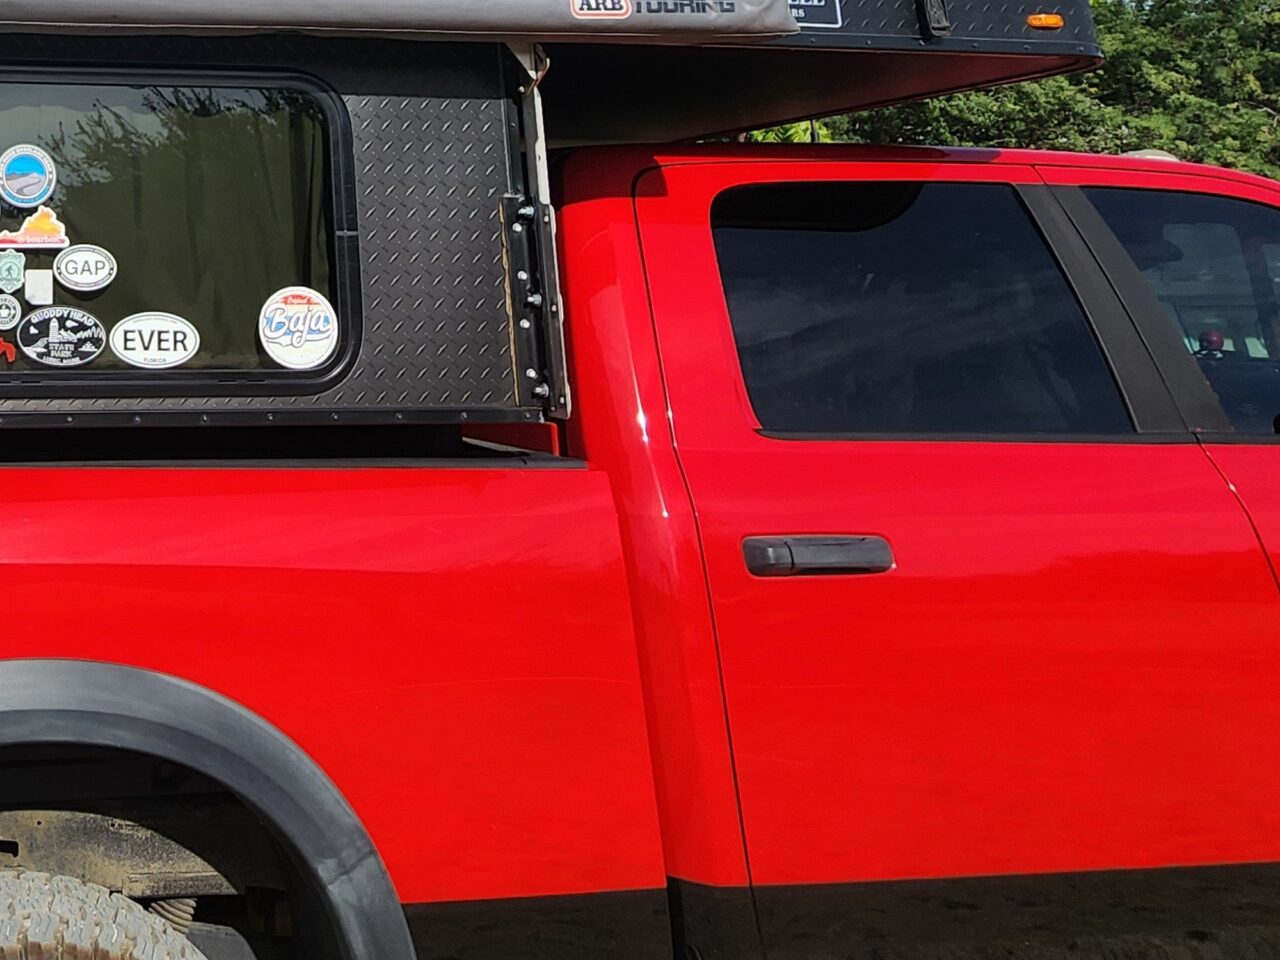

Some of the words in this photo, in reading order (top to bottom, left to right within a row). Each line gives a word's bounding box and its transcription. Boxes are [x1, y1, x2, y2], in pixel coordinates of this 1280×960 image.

[65, 259, 106, 276] GAP
[31, 309, 70, 324] QUODDY
[70, 310, 95, 327] HEAD
[263, 303, 332, 348] Baja
[123, 329, 188, 352] EVER
